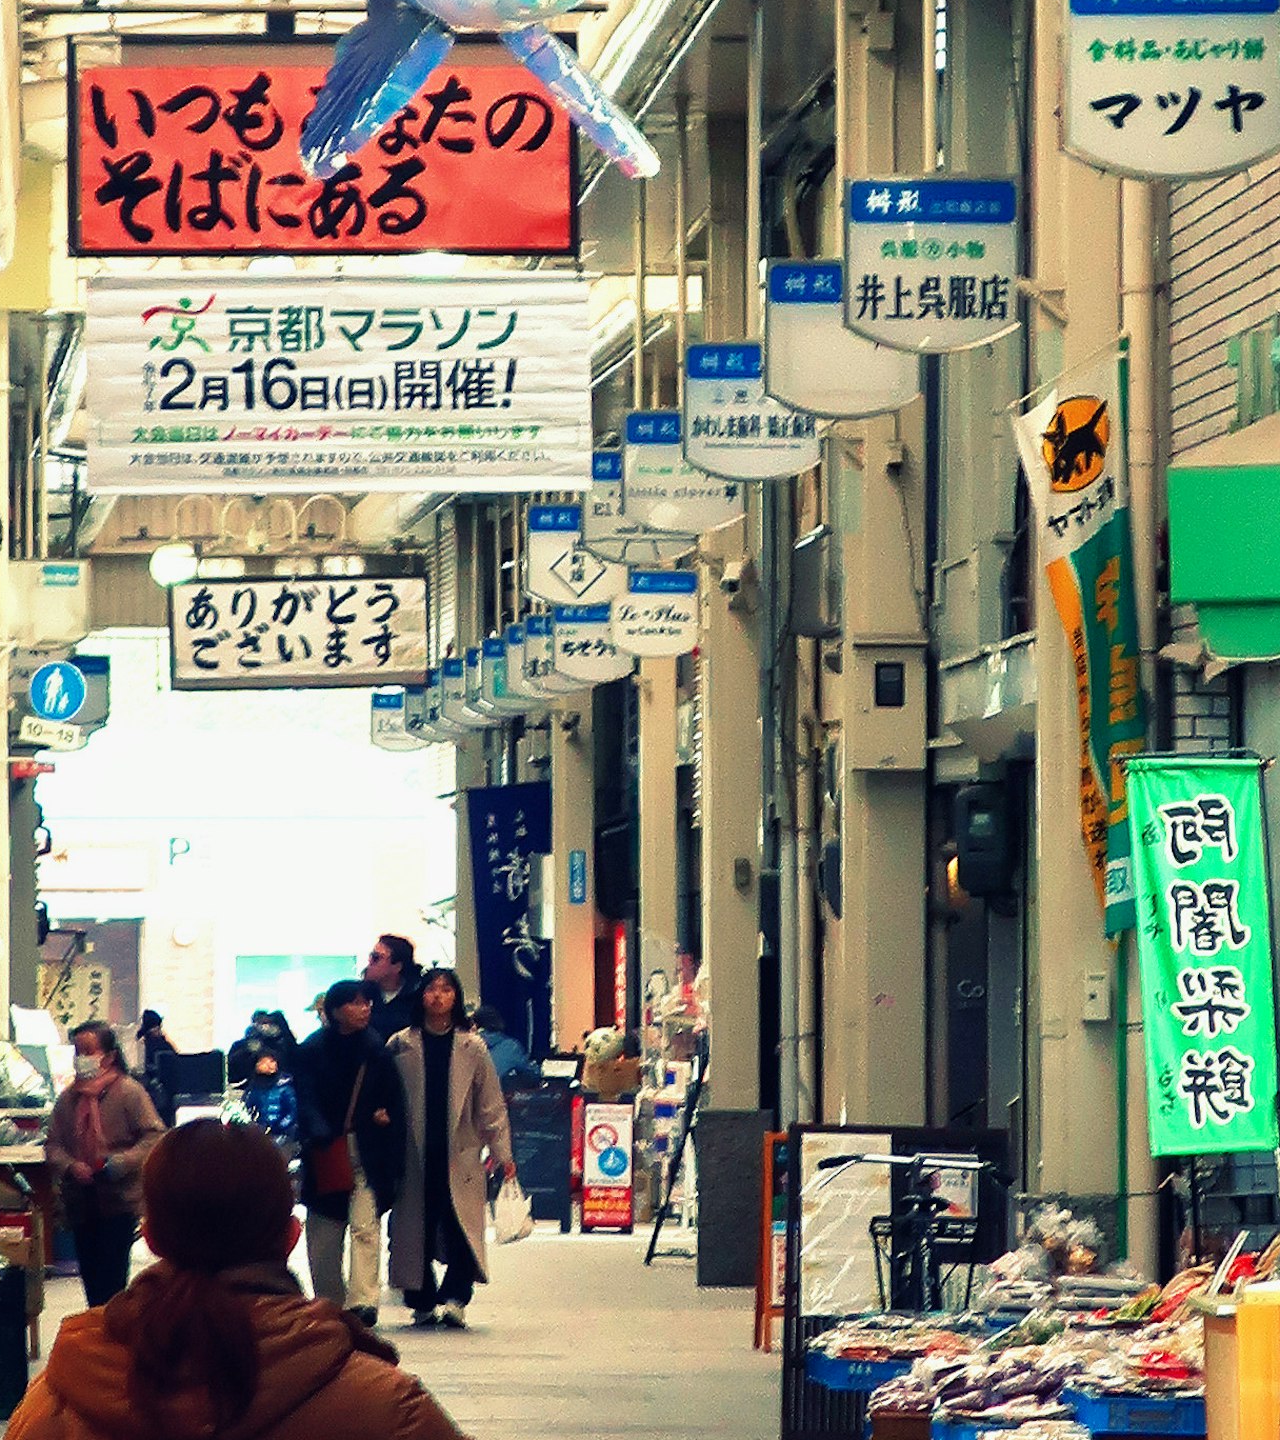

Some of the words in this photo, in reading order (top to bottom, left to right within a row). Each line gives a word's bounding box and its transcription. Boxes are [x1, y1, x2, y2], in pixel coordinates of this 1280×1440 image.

[90, 71, 555, 154] いつもたの
[1089, 83, 1268, 136] マツヤ
[96, 149, 426, 243] そばにある
[856, 273, 1012, 321] 井上呉服店
[225, 305, 519, 353] 京都マラソン
[186, 583, 401, 630] ありがとう
[191, 622, 401, 670] ございます
